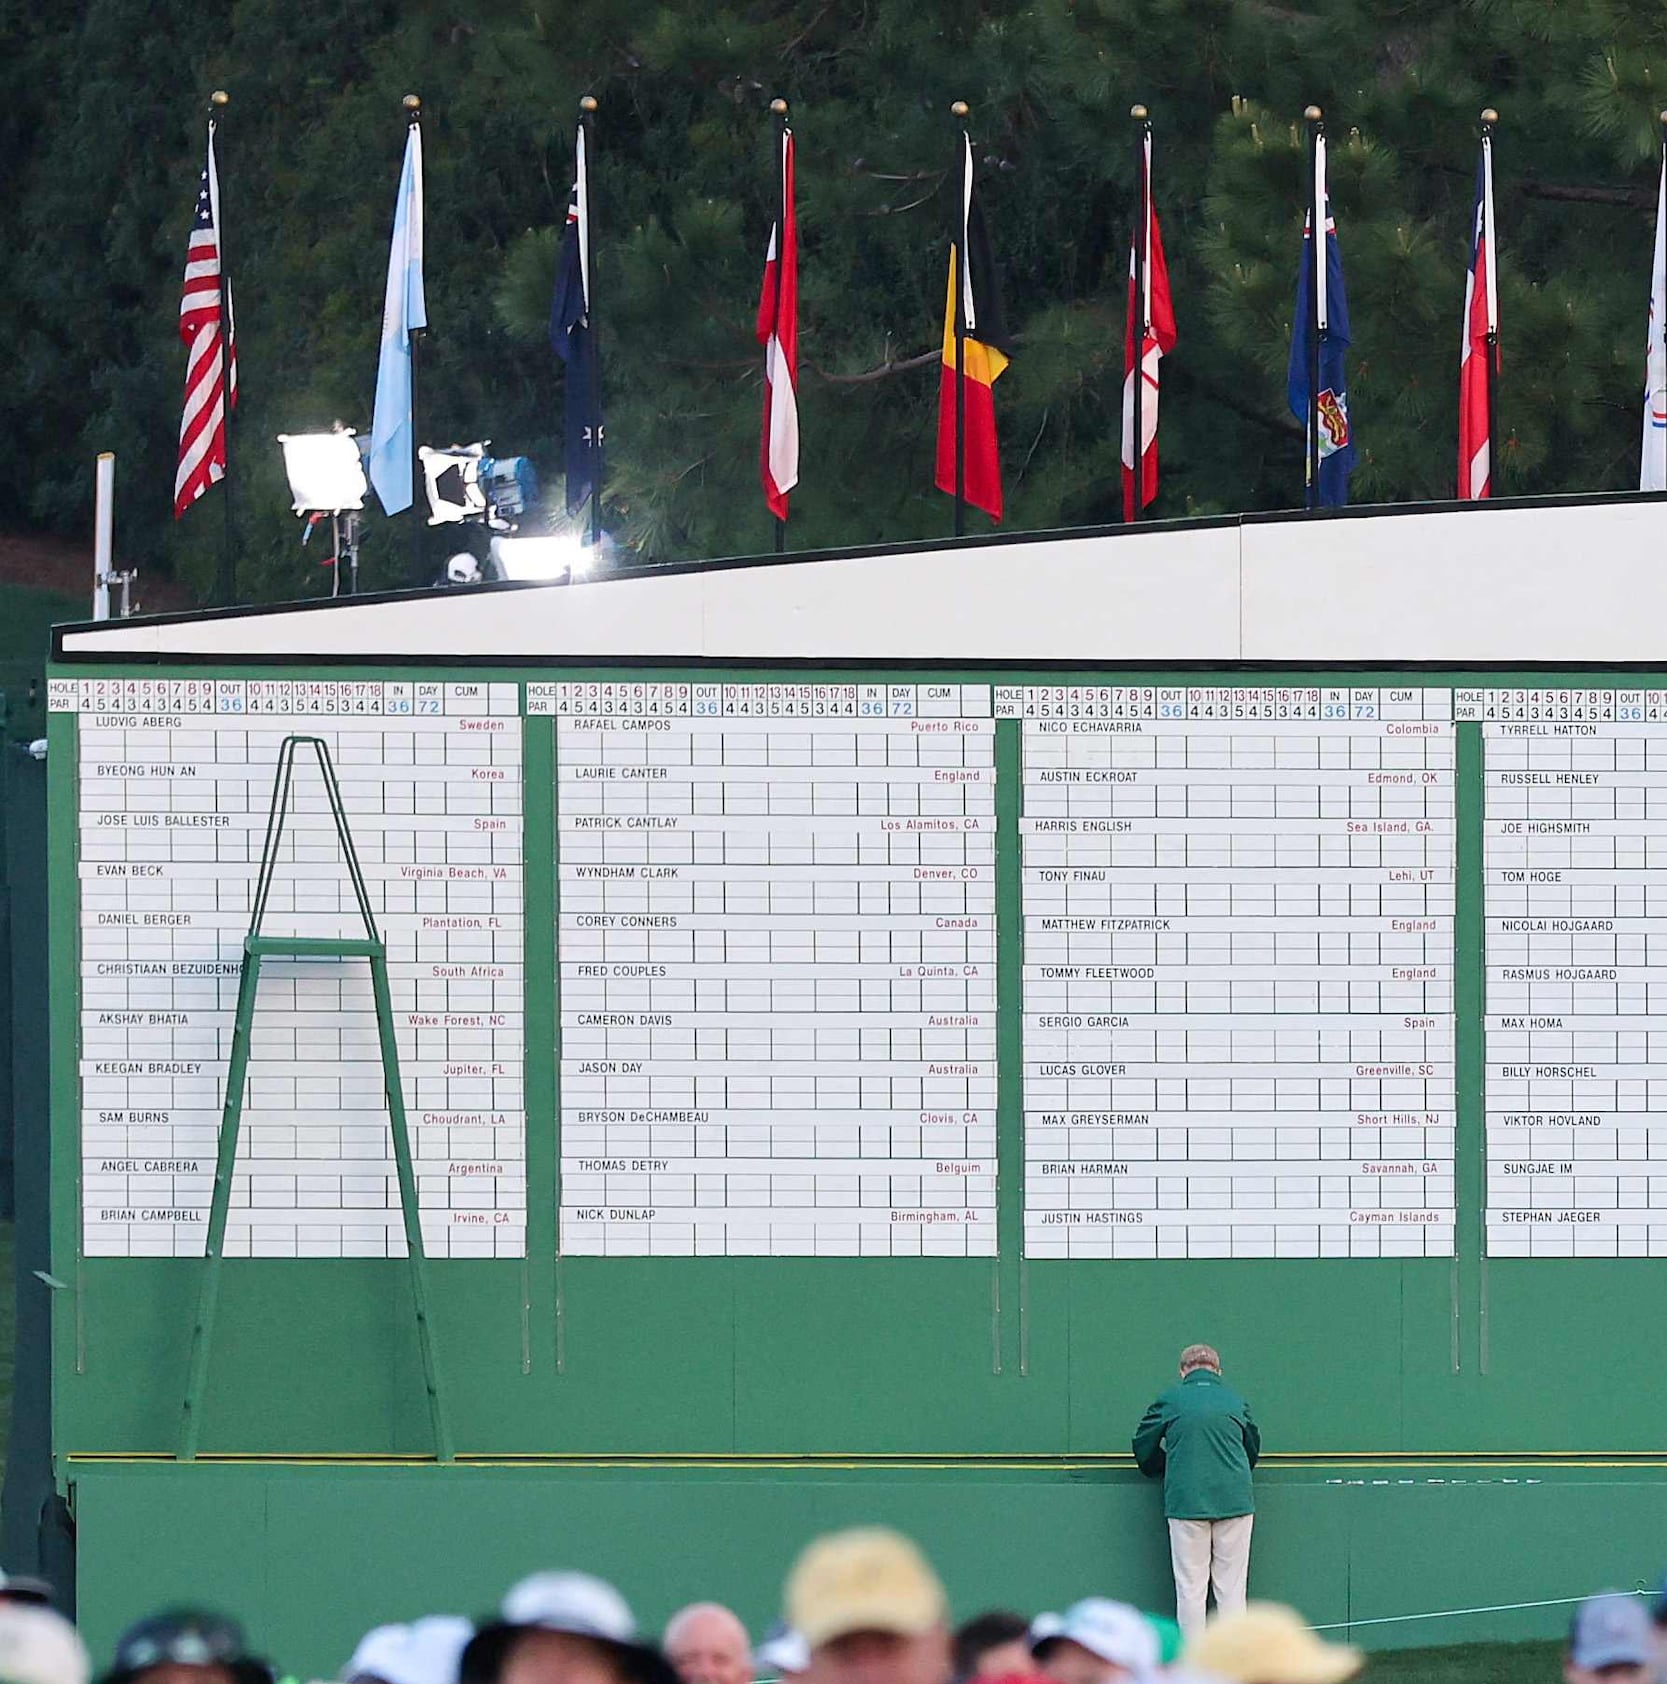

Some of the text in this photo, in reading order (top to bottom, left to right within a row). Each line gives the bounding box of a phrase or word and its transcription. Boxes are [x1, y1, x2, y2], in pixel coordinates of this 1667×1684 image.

[96, 716, 182, 728] LUDVIG ABERG
[459, 719, 504, 730] Sweden
[574, 719, 671, 731] RAFAEL CAMPOS
[911, 721, 979, 732] Puerto Rico
[1039, 722, 1142, 732] NICO ECHAVARRIA
[1386, 723, 1439, 734] Colombia
[1500, 724, 1596, 736] TYRRELL HATTON
[97, 814, 230, 827] JOSE LUIS BALLESTER
[474, 818, 506, 830] Spain
[1500, 822, 1590, 834] JOE HIGHSMITH
[576, 915, 677, 928] COREY CONNERS
[936, 917, 978, 928] Canada
[1042, 919, 1170, 930] MATTHEW FITZPATRICK
[1392, 919, 1436, 932] England
[99, 1014, 188, 1025] AKSHAY BHATIA
[408, 1015, 438, 1025] Wake
[489, 1014, 505, 1026] NC
[578, 1111, 709, 1123] BRYSON DeCHAMBEAU
[962, 1112, 978, 1124] CA
[1503, 1115, 1601, 1126] VIKTOR HOVLAND
[578, 1160, 668, 1171] THOMAS DETRY
[936, 1162, 981, 1176] Belguim
[1041, 1212, 1143, 1224] JUSTIN HASTINGS
[1350, 1210, 1439, 1224] Cayman Islands
